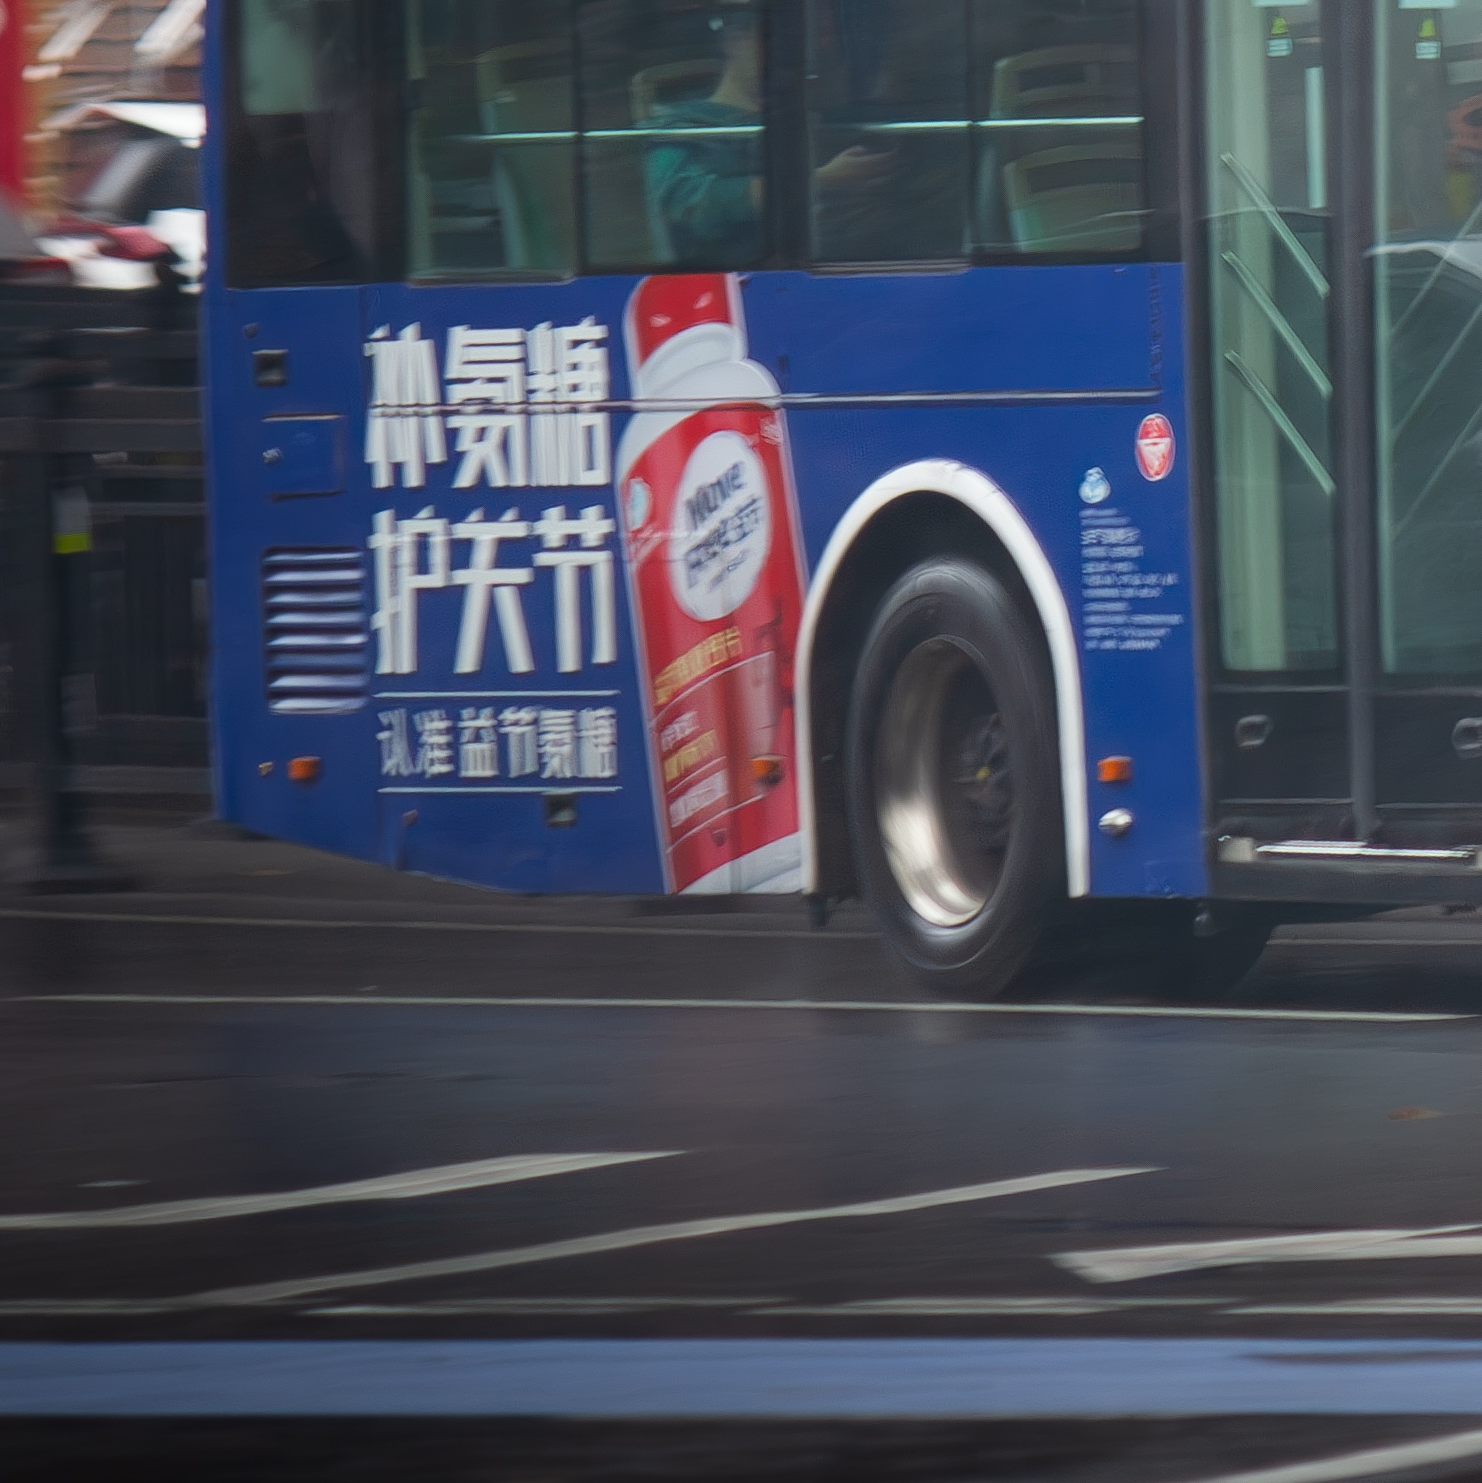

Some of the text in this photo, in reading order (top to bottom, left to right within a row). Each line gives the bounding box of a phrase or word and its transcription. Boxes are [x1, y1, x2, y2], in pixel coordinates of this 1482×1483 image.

[363, 315, 612, 489] 补氨糖
[367, 505, 617, 673] 护关节
[376, 706, 618, 779] 认准益节氨糖
